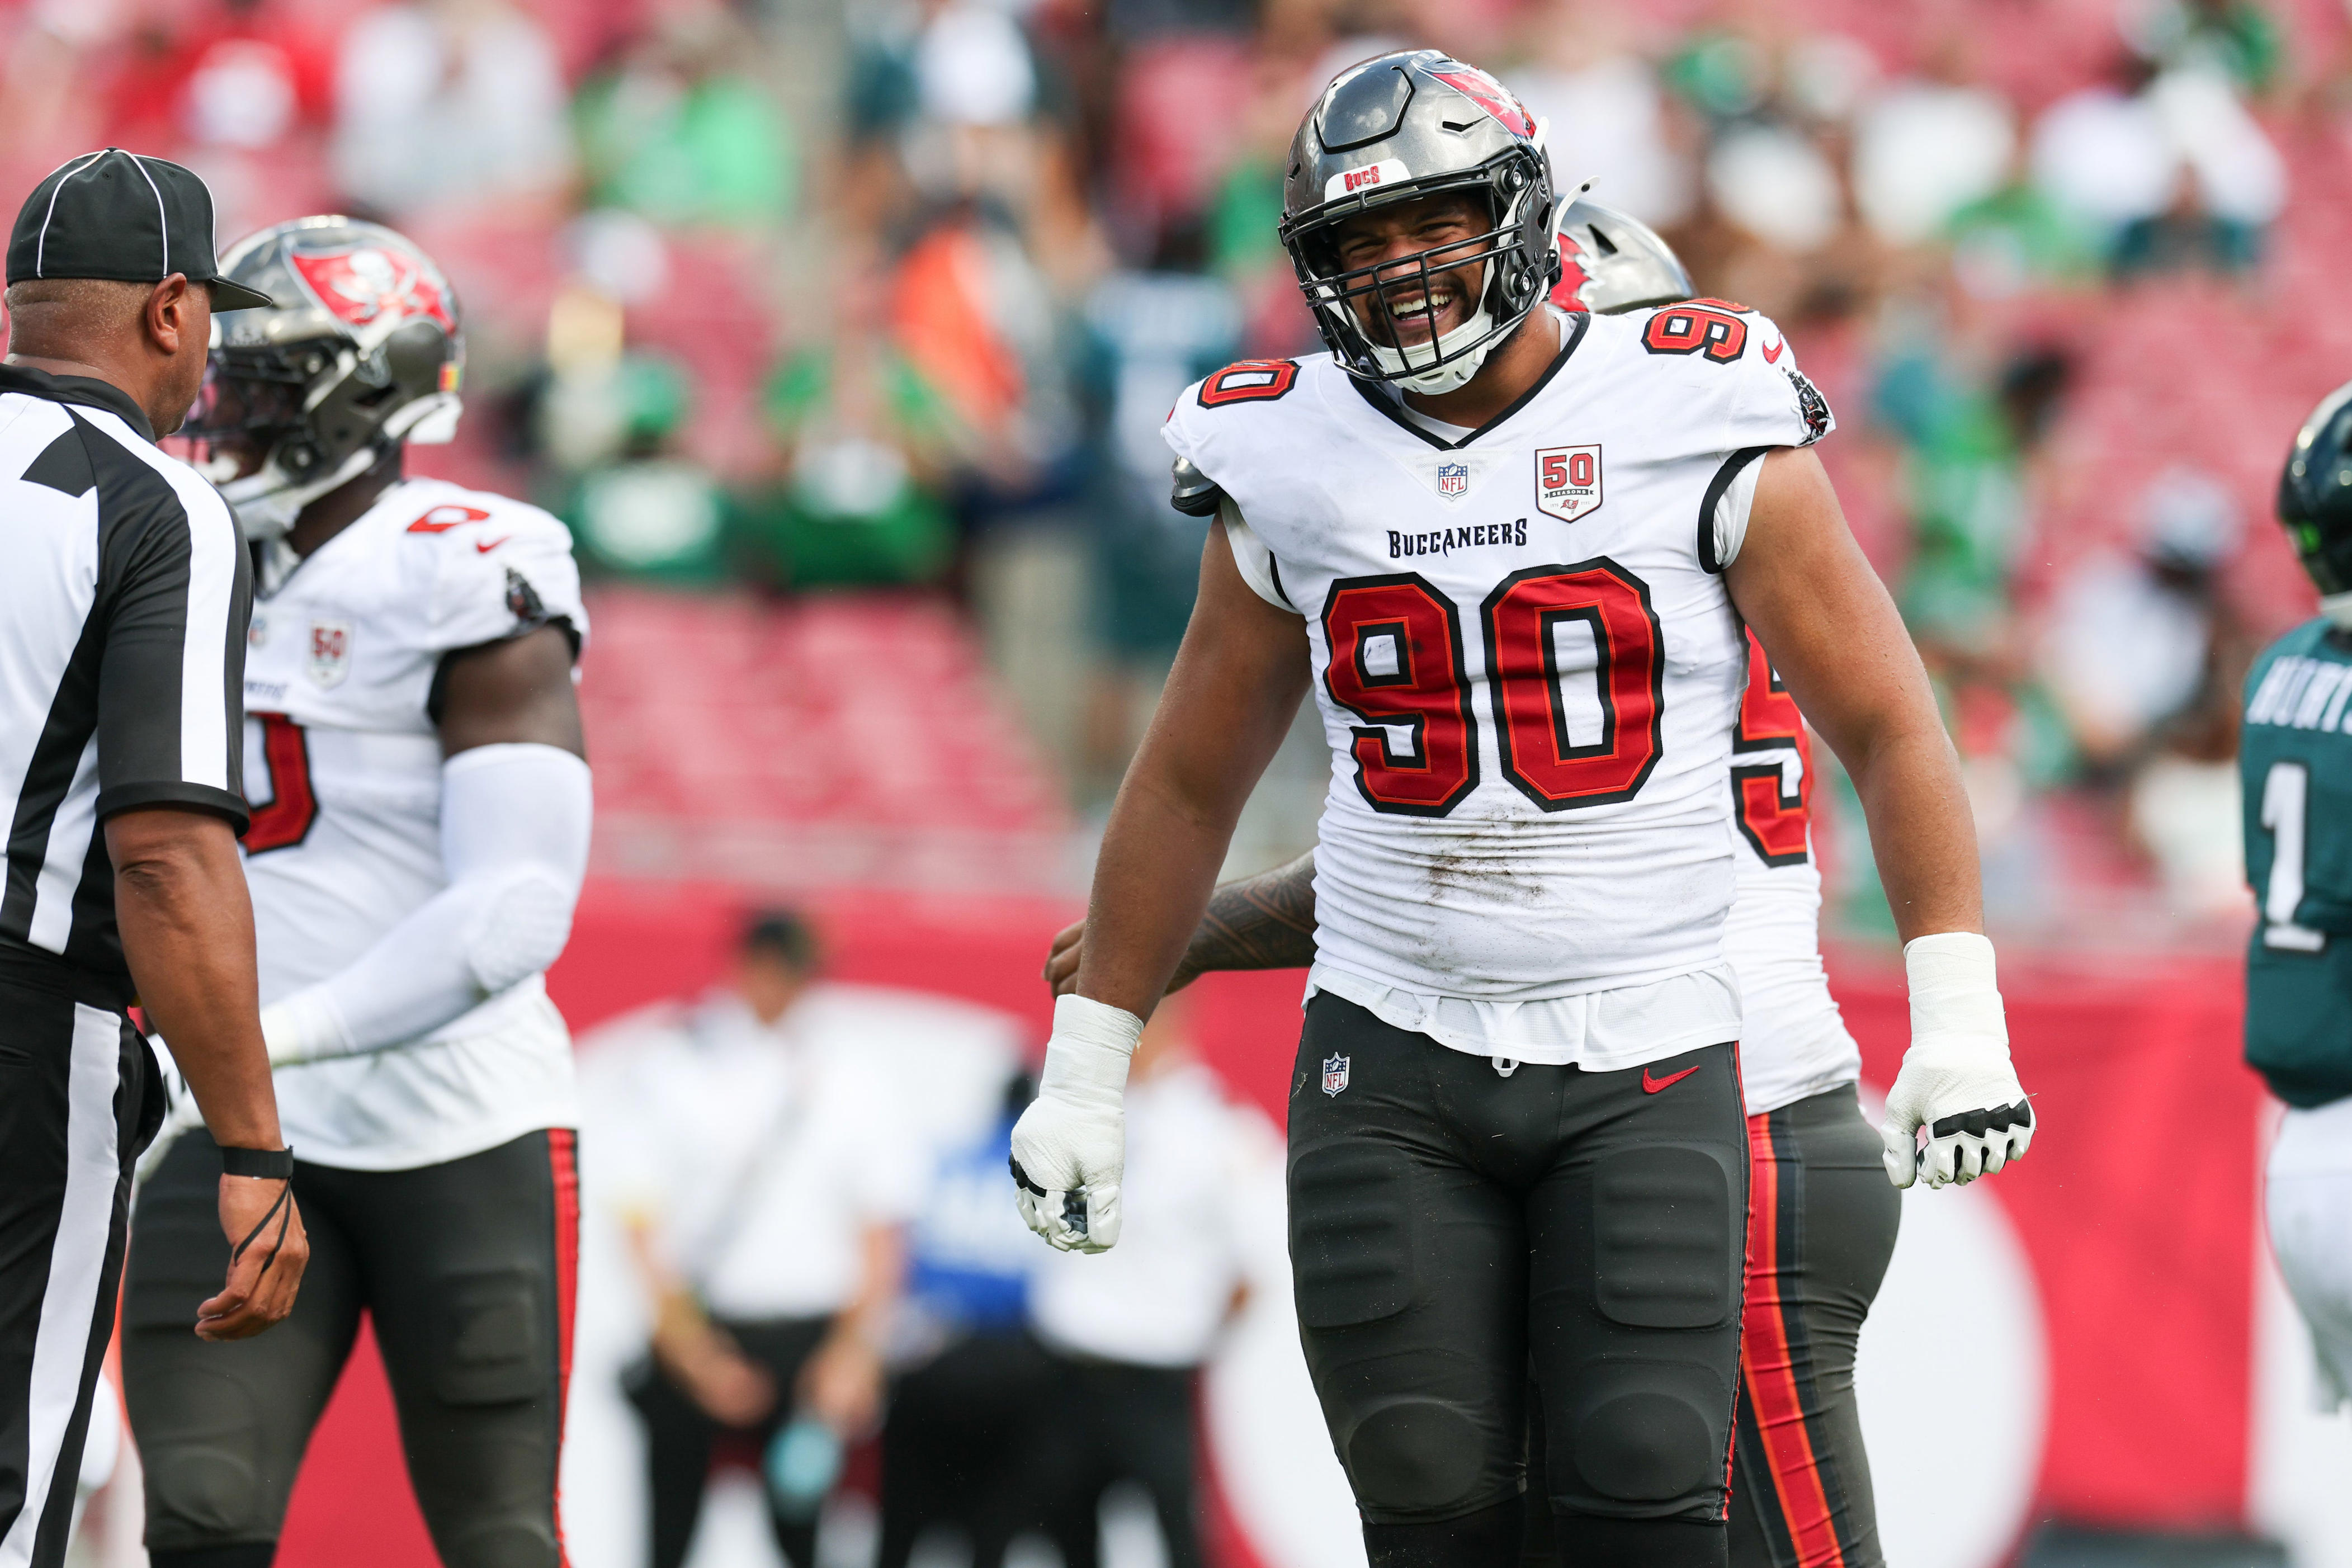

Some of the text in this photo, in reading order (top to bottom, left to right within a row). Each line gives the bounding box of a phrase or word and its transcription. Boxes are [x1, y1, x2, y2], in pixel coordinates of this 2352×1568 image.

[1344, 166, 1380, 191] BUCS
[1641, 297, 1754, 365] 9
[1441, 477, 1464, 492] NFL
[1543, 453, 1594, 489] 50
[1387, 518, 1527, 558] BUCCANEERS
[1320, 556, 1665, 818] 90
[2246, 654, 2352, 735] HURT
[1326, 1073, 1343, 1089] NFL
